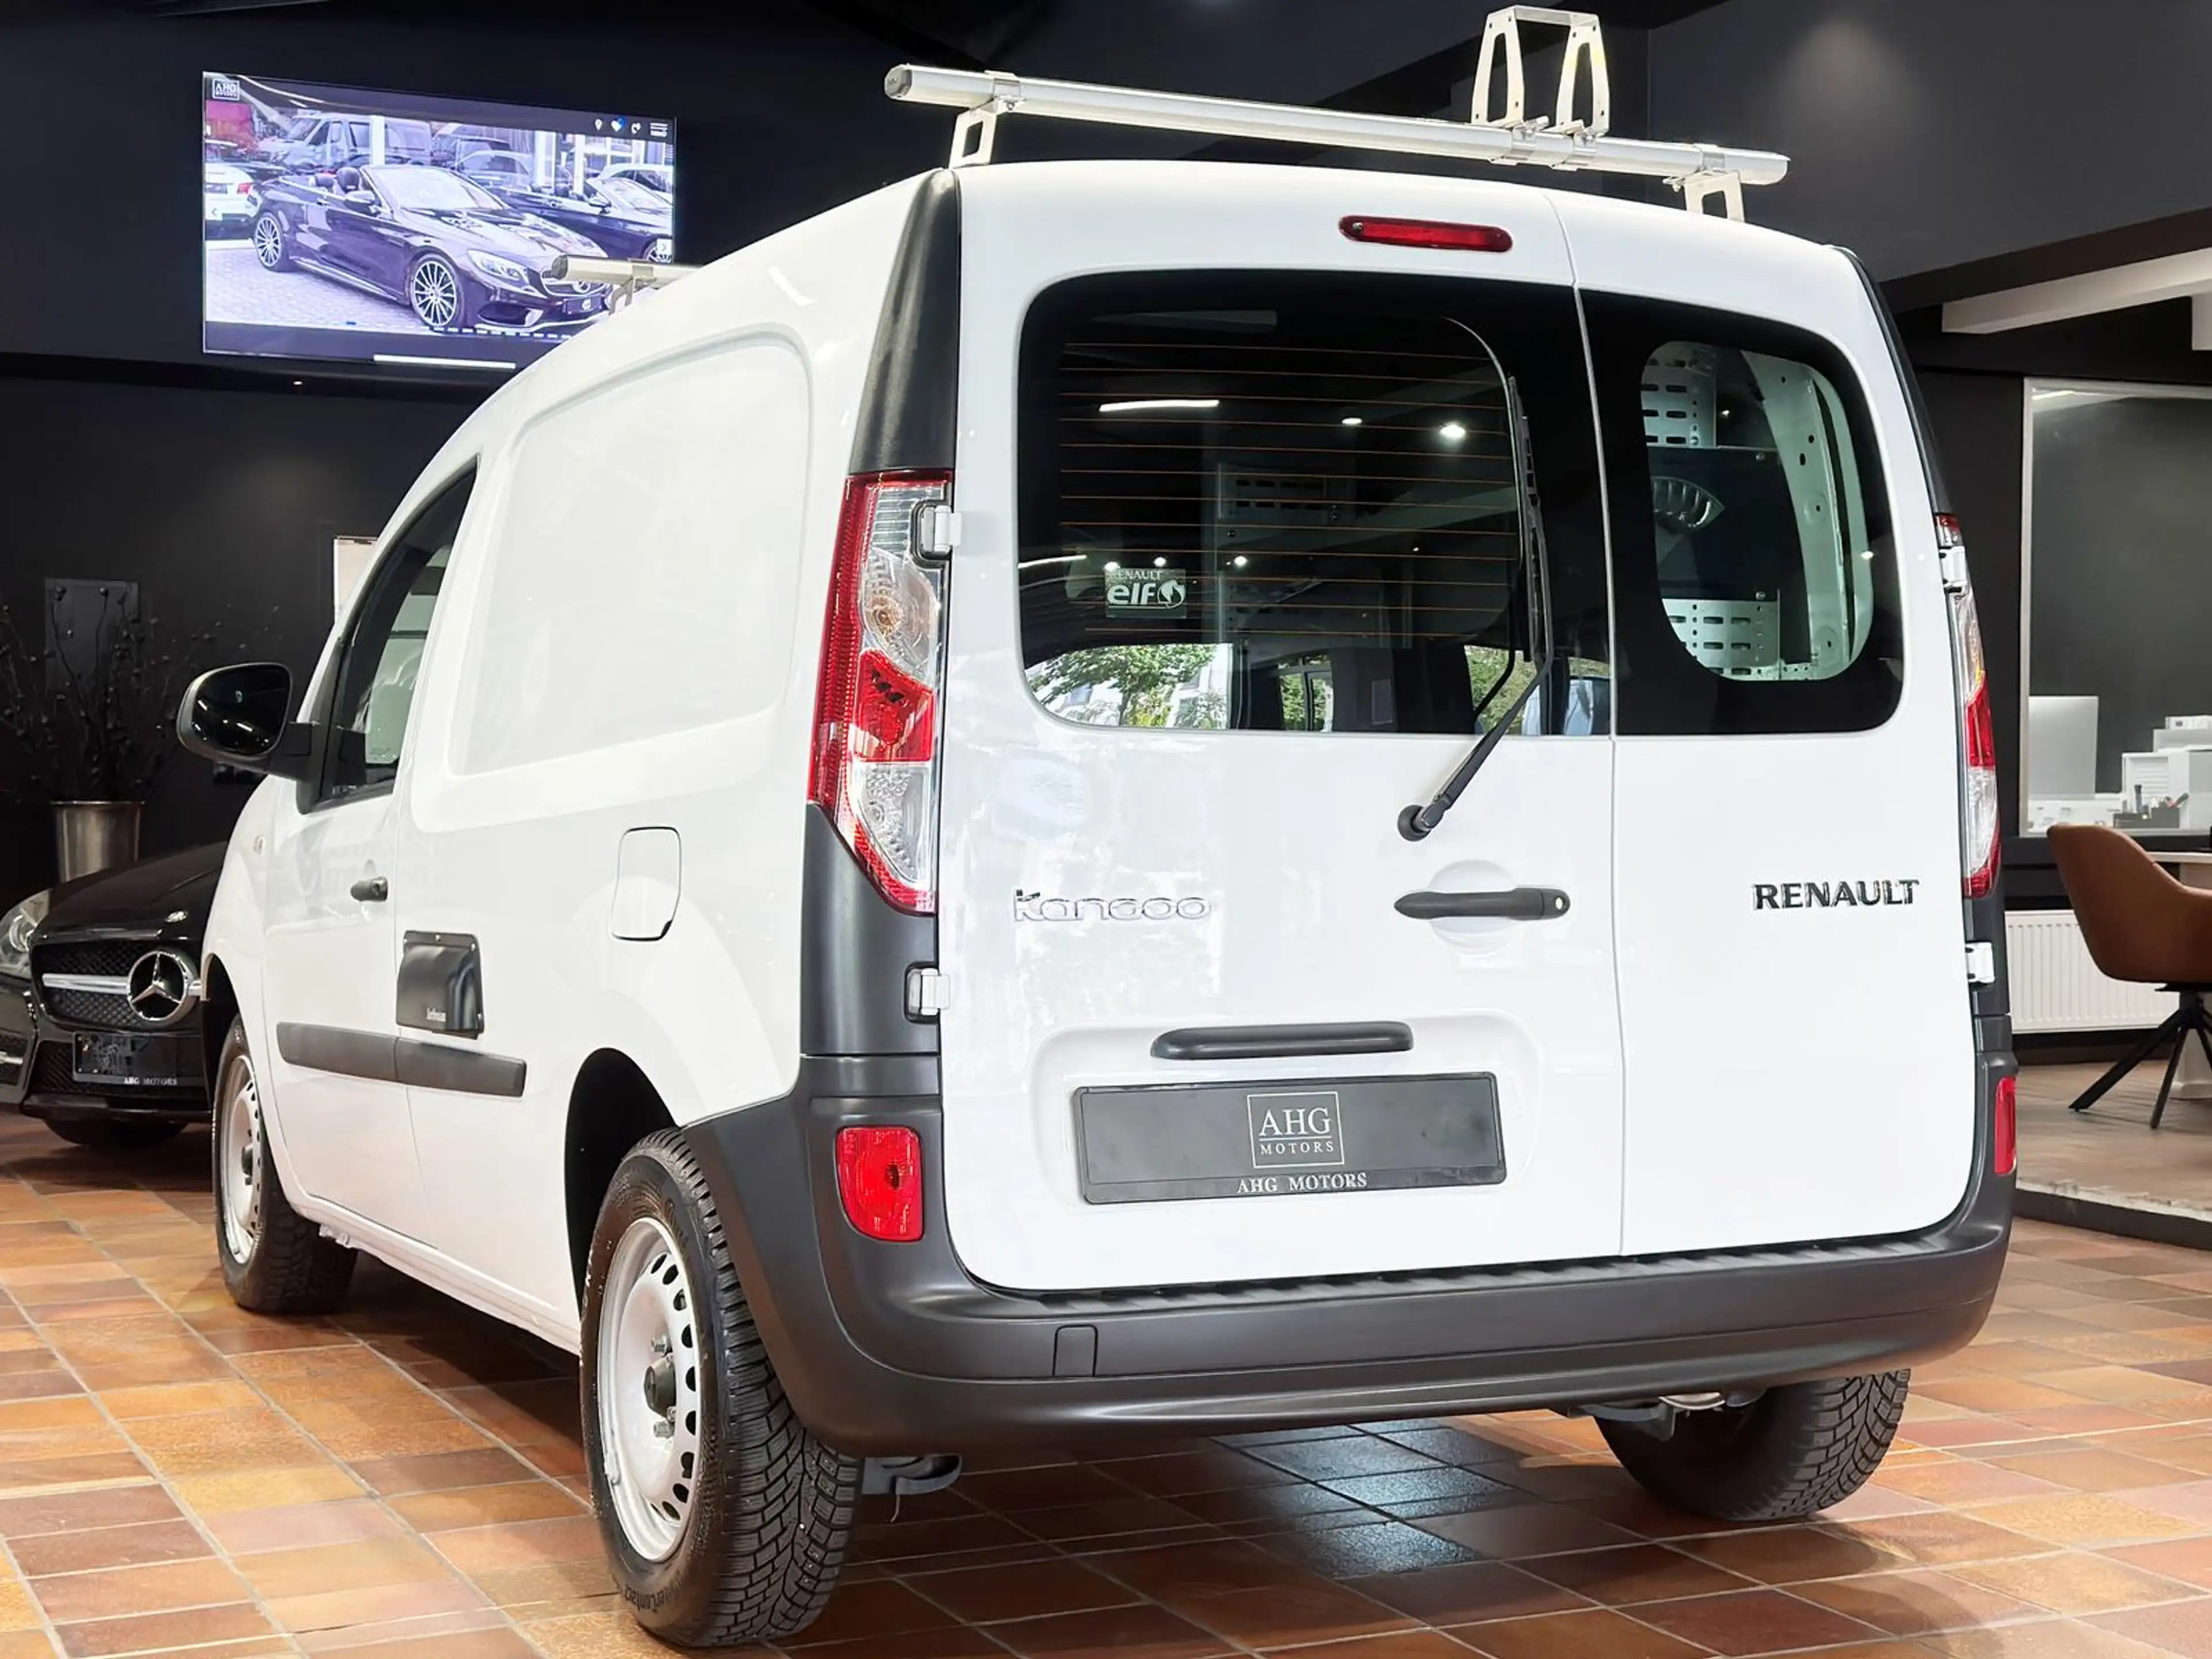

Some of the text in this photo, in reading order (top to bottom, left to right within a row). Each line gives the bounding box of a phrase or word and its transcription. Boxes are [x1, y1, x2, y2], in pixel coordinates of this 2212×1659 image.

[1107, 582, 1156, 605] elf
[1752, 880, 1919, 910] RENAULT
[1259, 1107, 1332, 1136] AHG
[1260, 1141, 1334, 1155] MOTORS
[1237, 1172, 1368, 1194] AHG MOTORS
